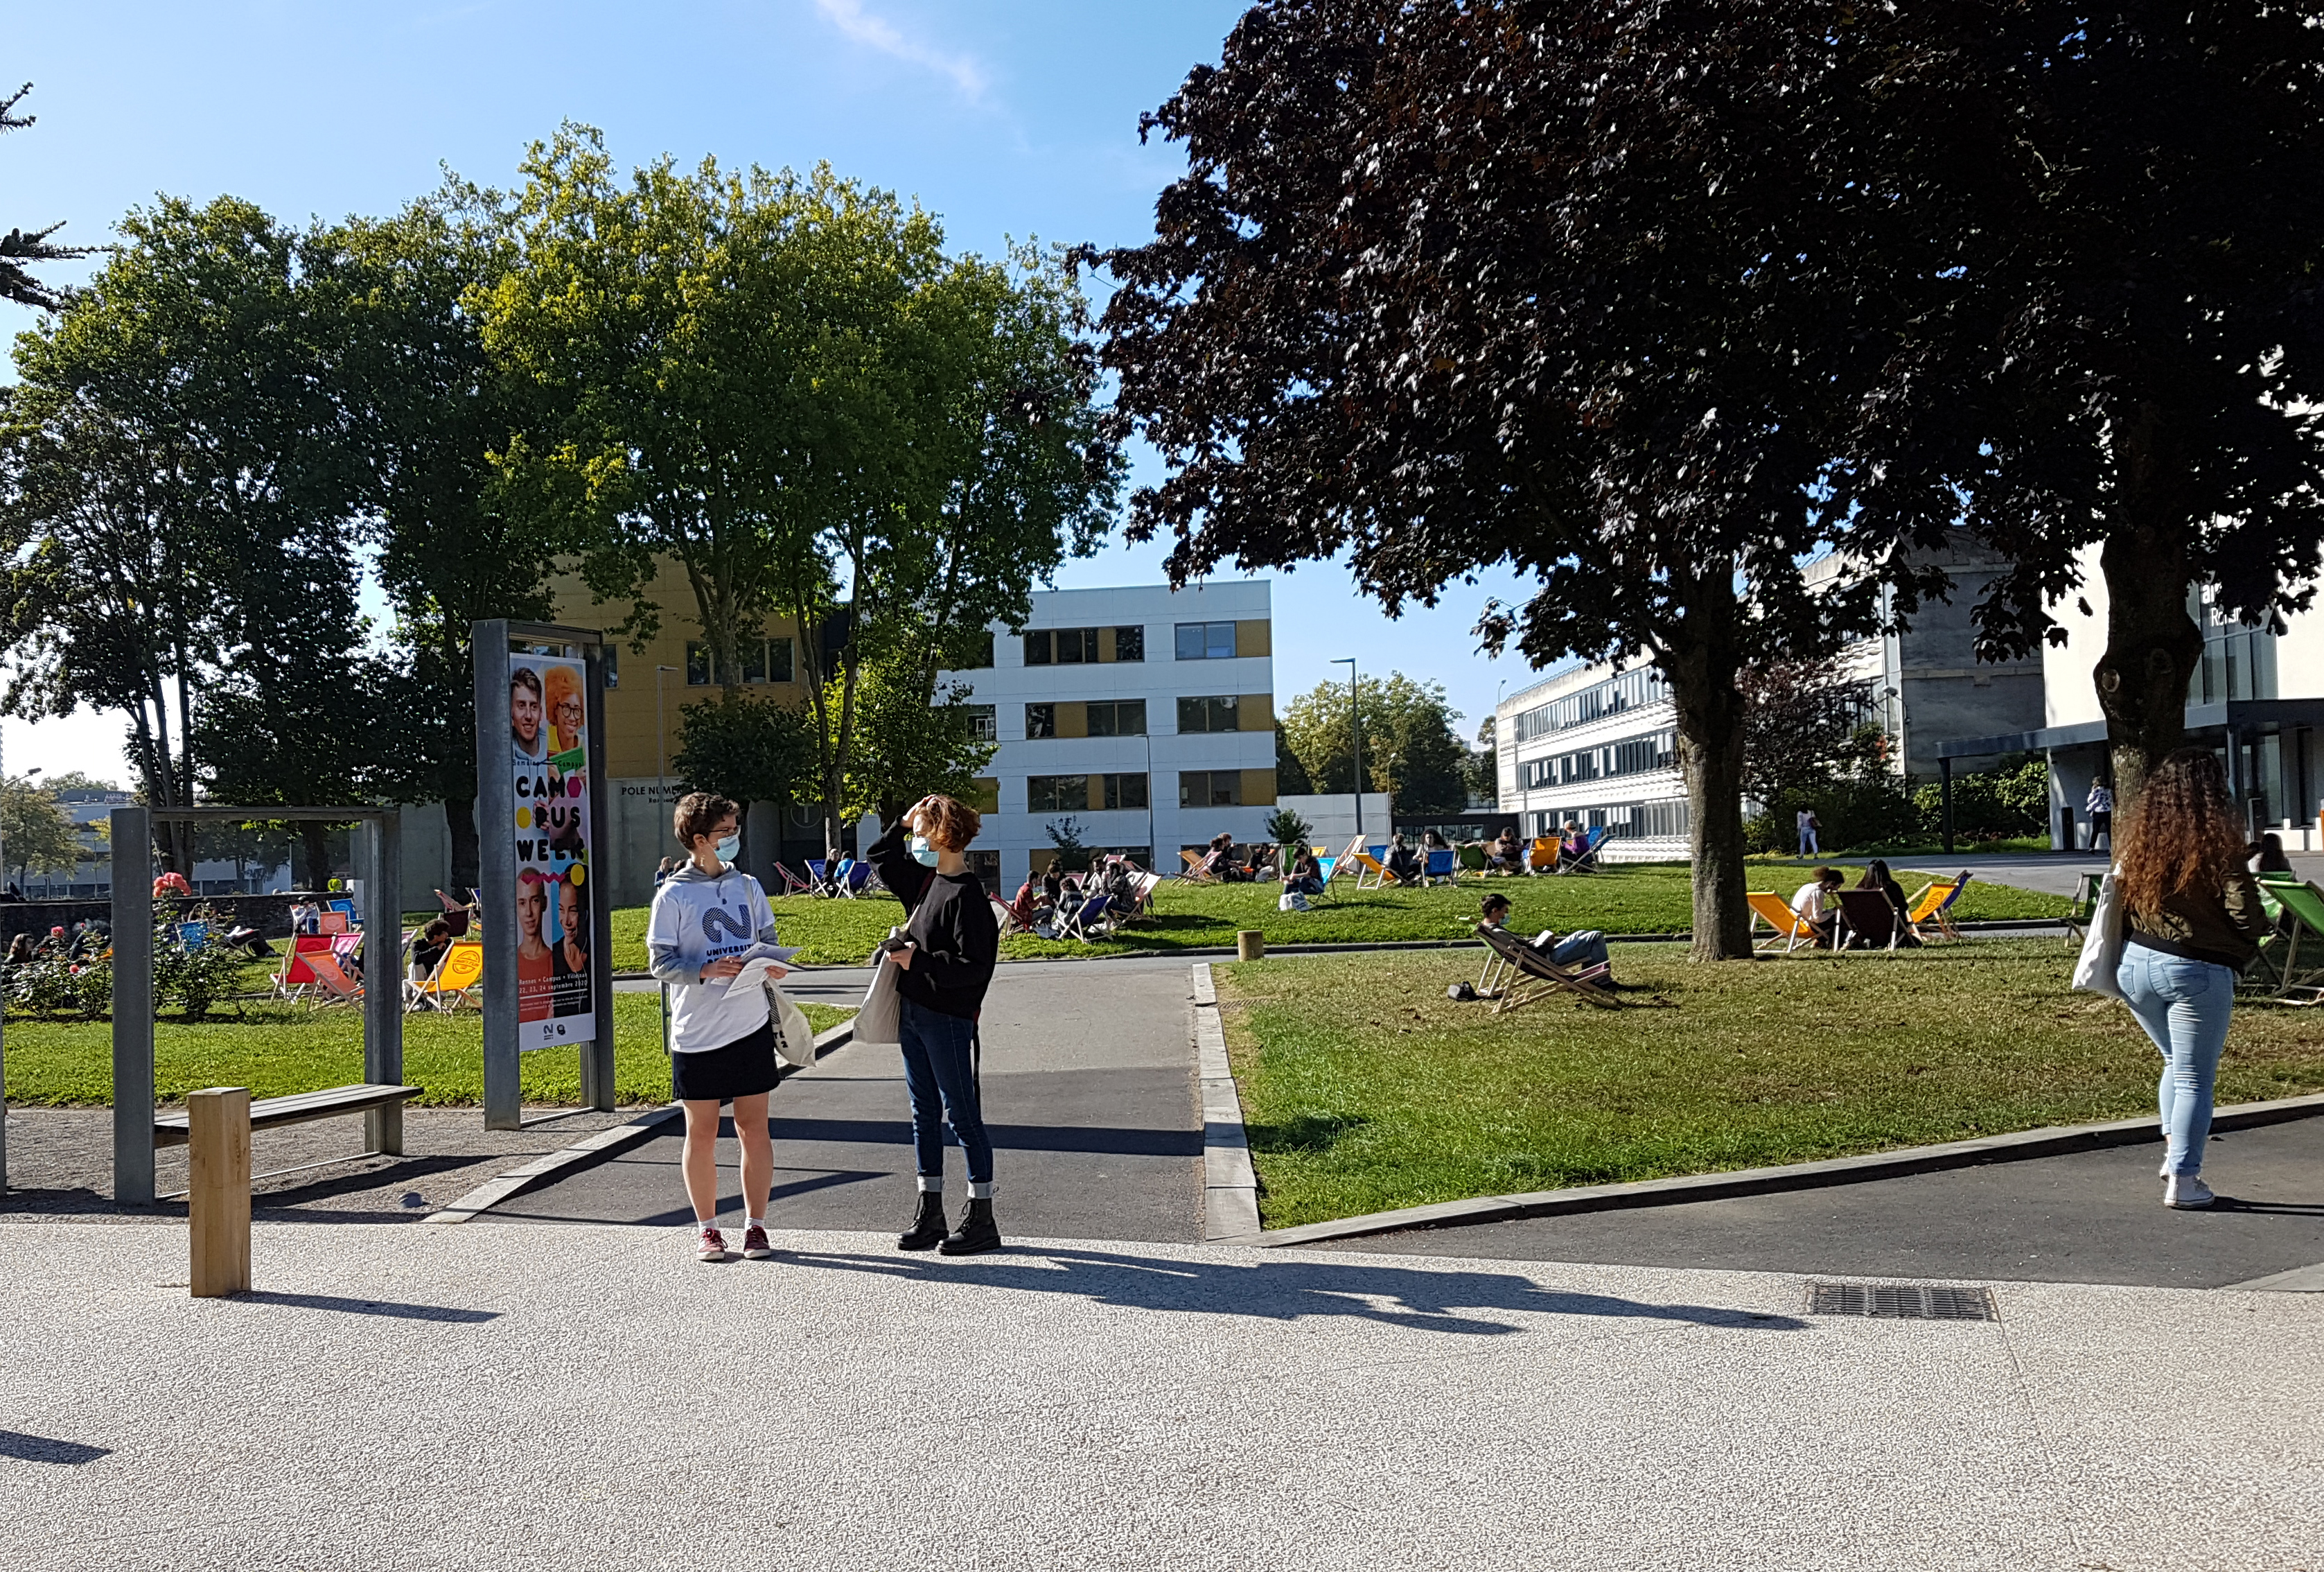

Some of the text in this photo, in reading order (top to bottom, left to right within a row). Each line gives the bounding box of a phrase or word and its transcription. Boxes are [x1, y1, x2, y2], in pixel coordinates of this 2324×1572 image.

[622, 787, 645, 795] POLE
[516, 838, 585, 862] WEEK
[706, 943, 754, 957] UNIVERSIT
